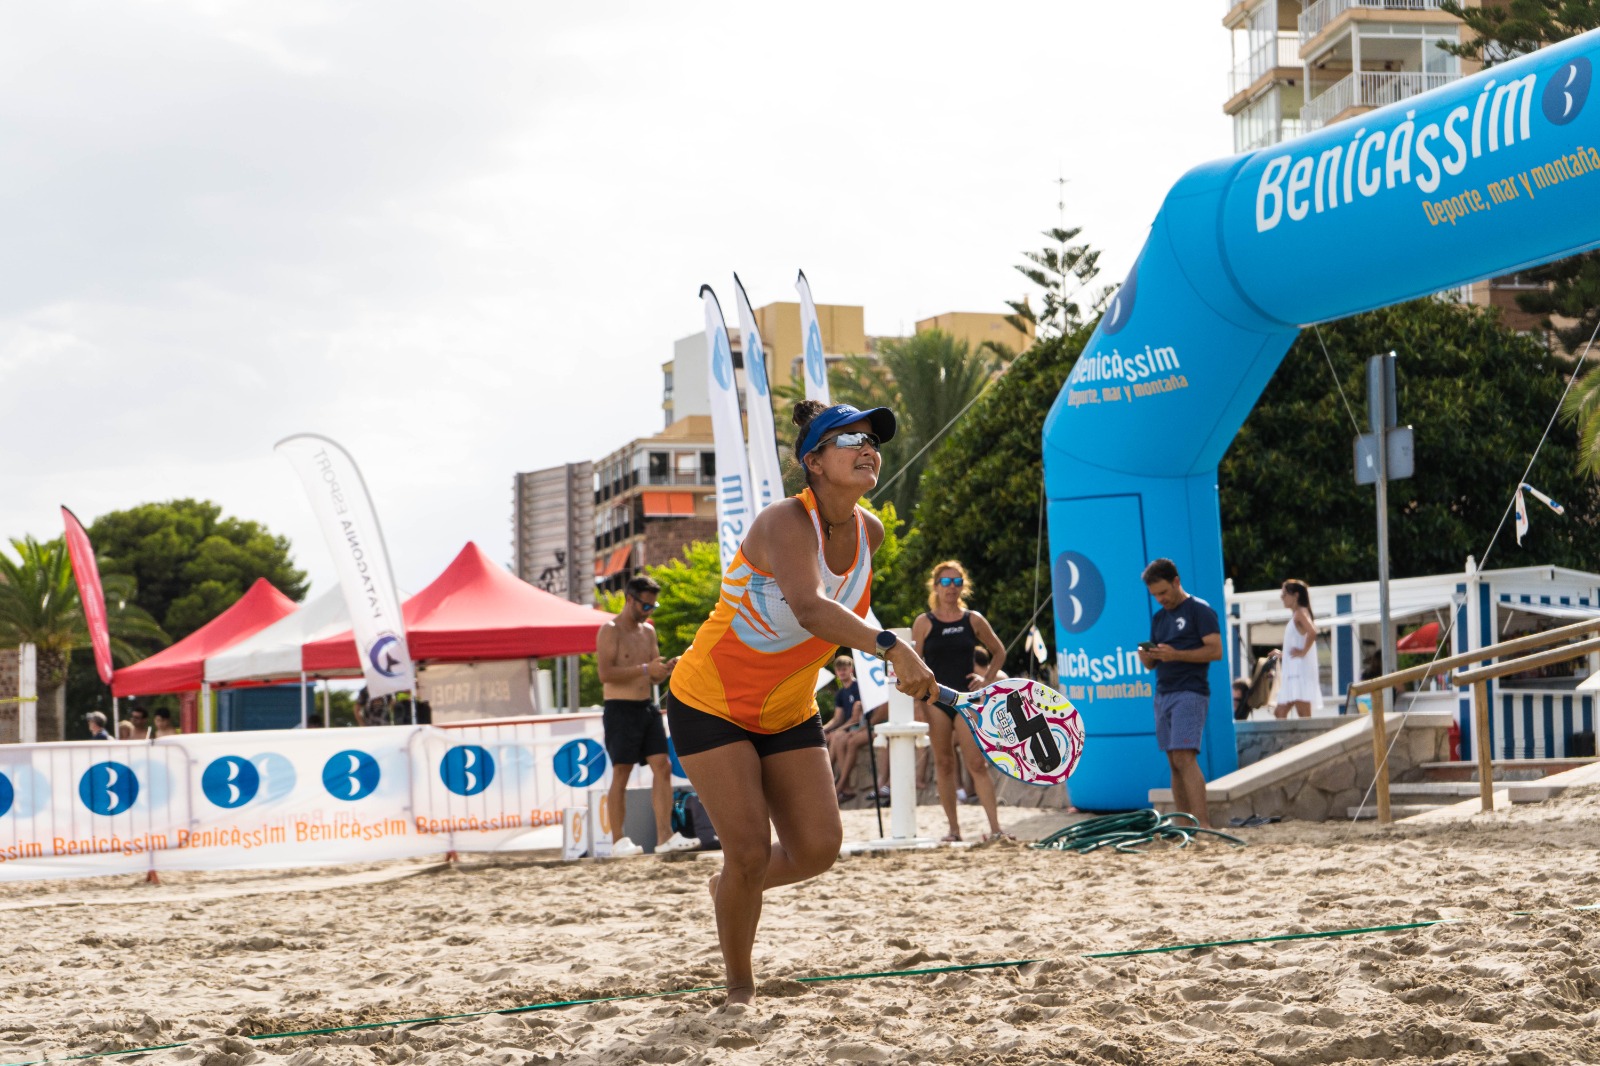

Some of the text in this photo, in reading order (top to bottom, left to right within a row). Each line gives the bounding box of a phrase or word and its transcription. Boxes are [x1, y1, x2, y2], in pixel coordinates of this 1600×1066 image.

[1422, 146, 1600, 226] Deporte, mar y montaña
[1102, 386, 1122, 402] mar
[1123, 385, 1133, 403] y
[1133, 374, 1189, 398] montaña
[1087, 685, 1094, 704] y
[1096, 680, 1152, 700] montaña
